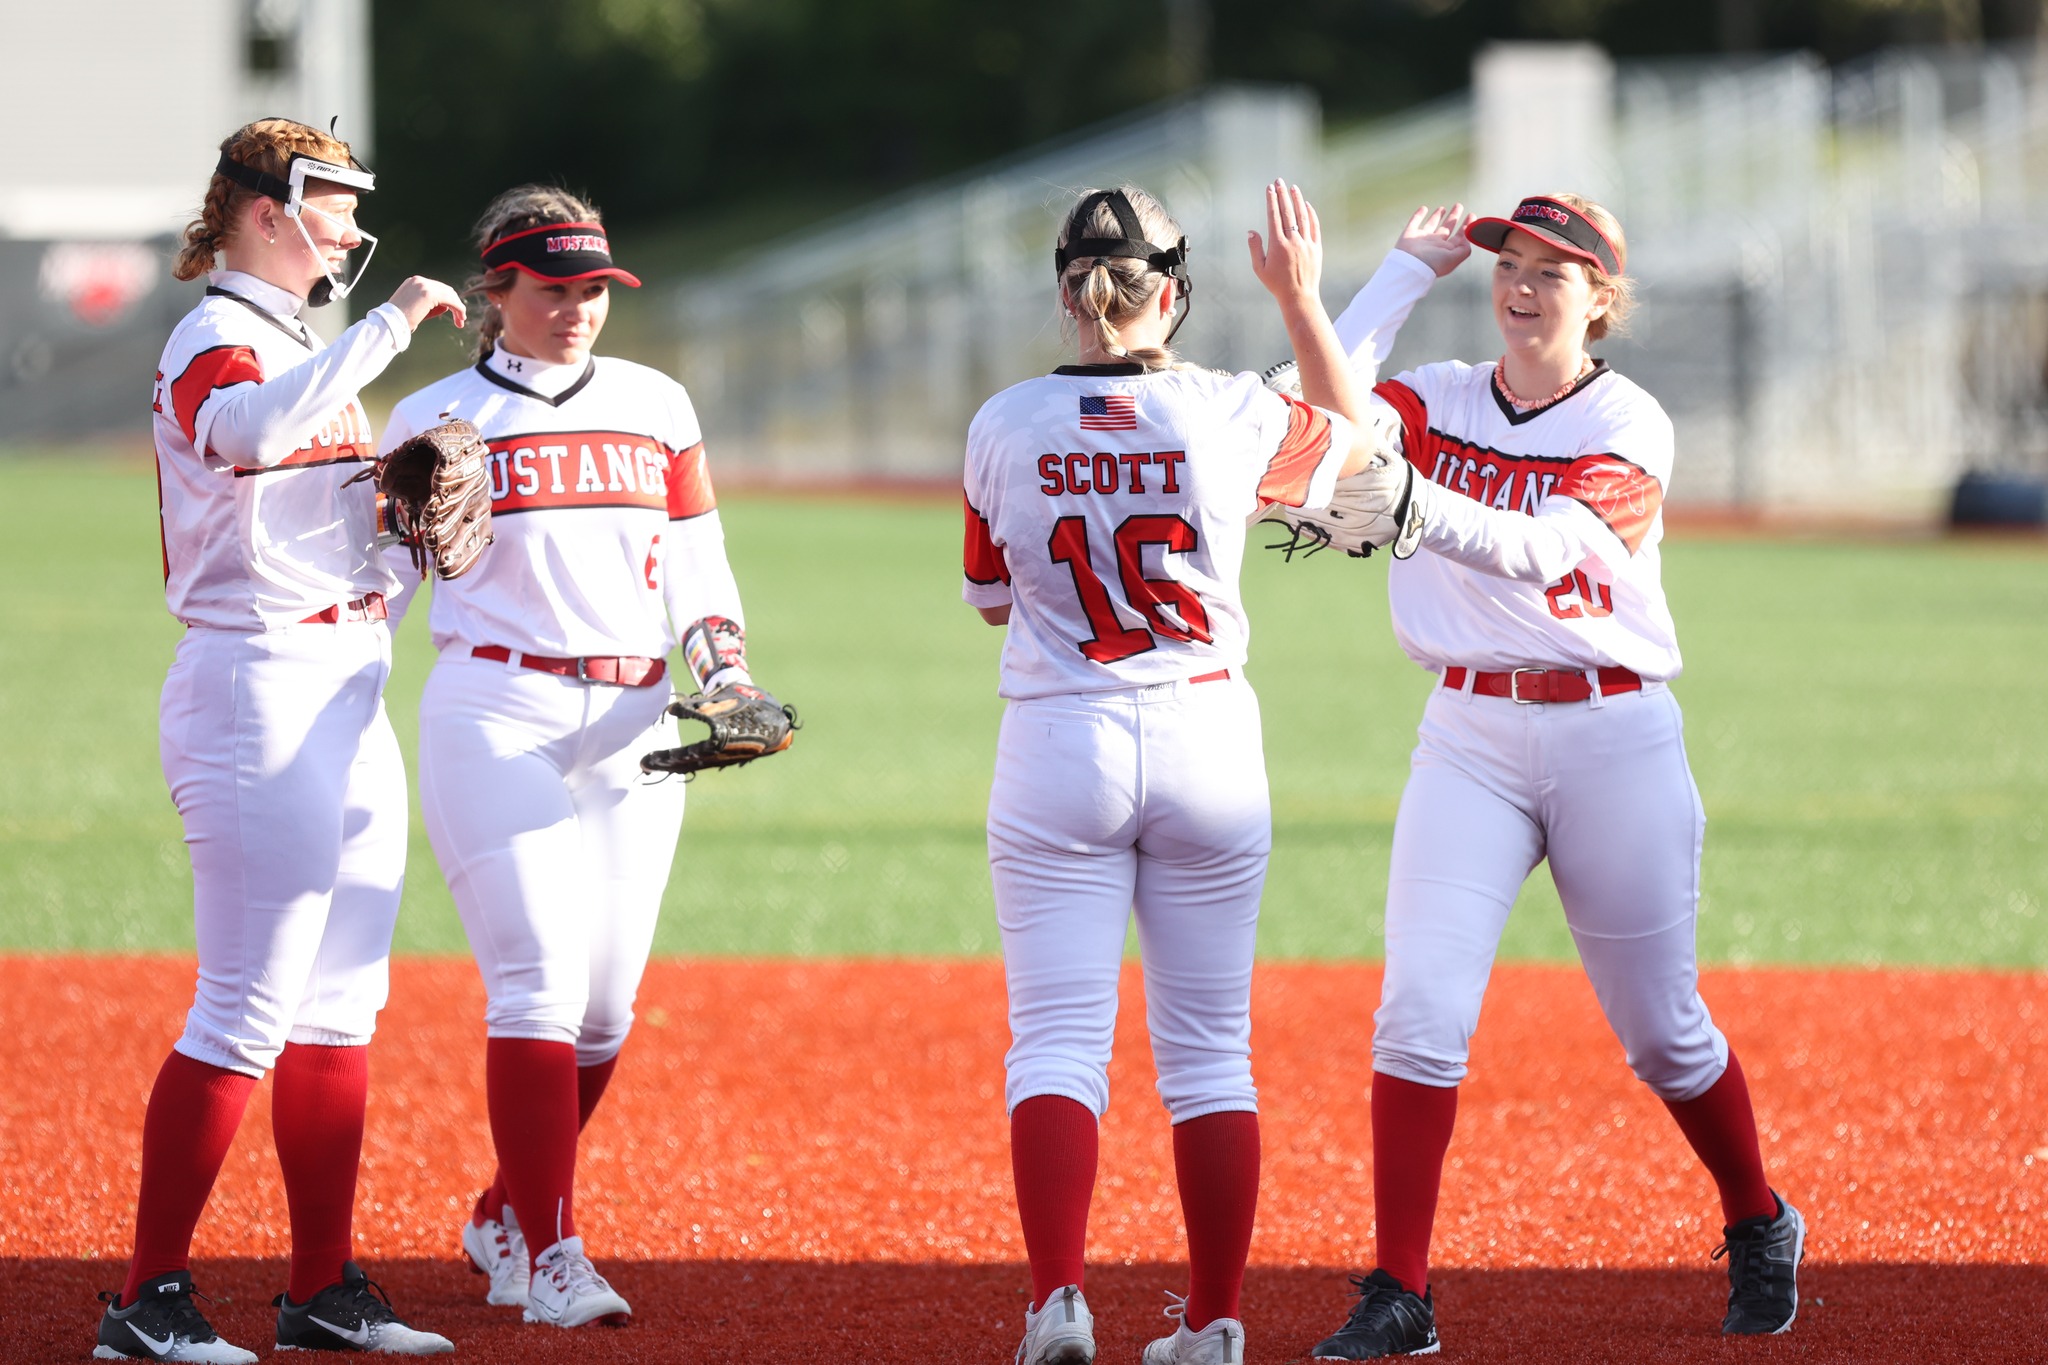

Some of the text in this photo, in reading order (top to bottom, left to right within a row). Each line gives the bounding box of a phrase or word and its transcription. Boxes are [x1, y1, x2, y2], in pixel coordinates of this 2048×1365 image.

[486, 443, 669, 500] USTANGS
[1037, 450, 1186, 496] SCOTT
[1429, 451, 1564, 518] USTAN
[1047, 514, 1214, 665] 16
[1544, 567, 1614, 620] 20
